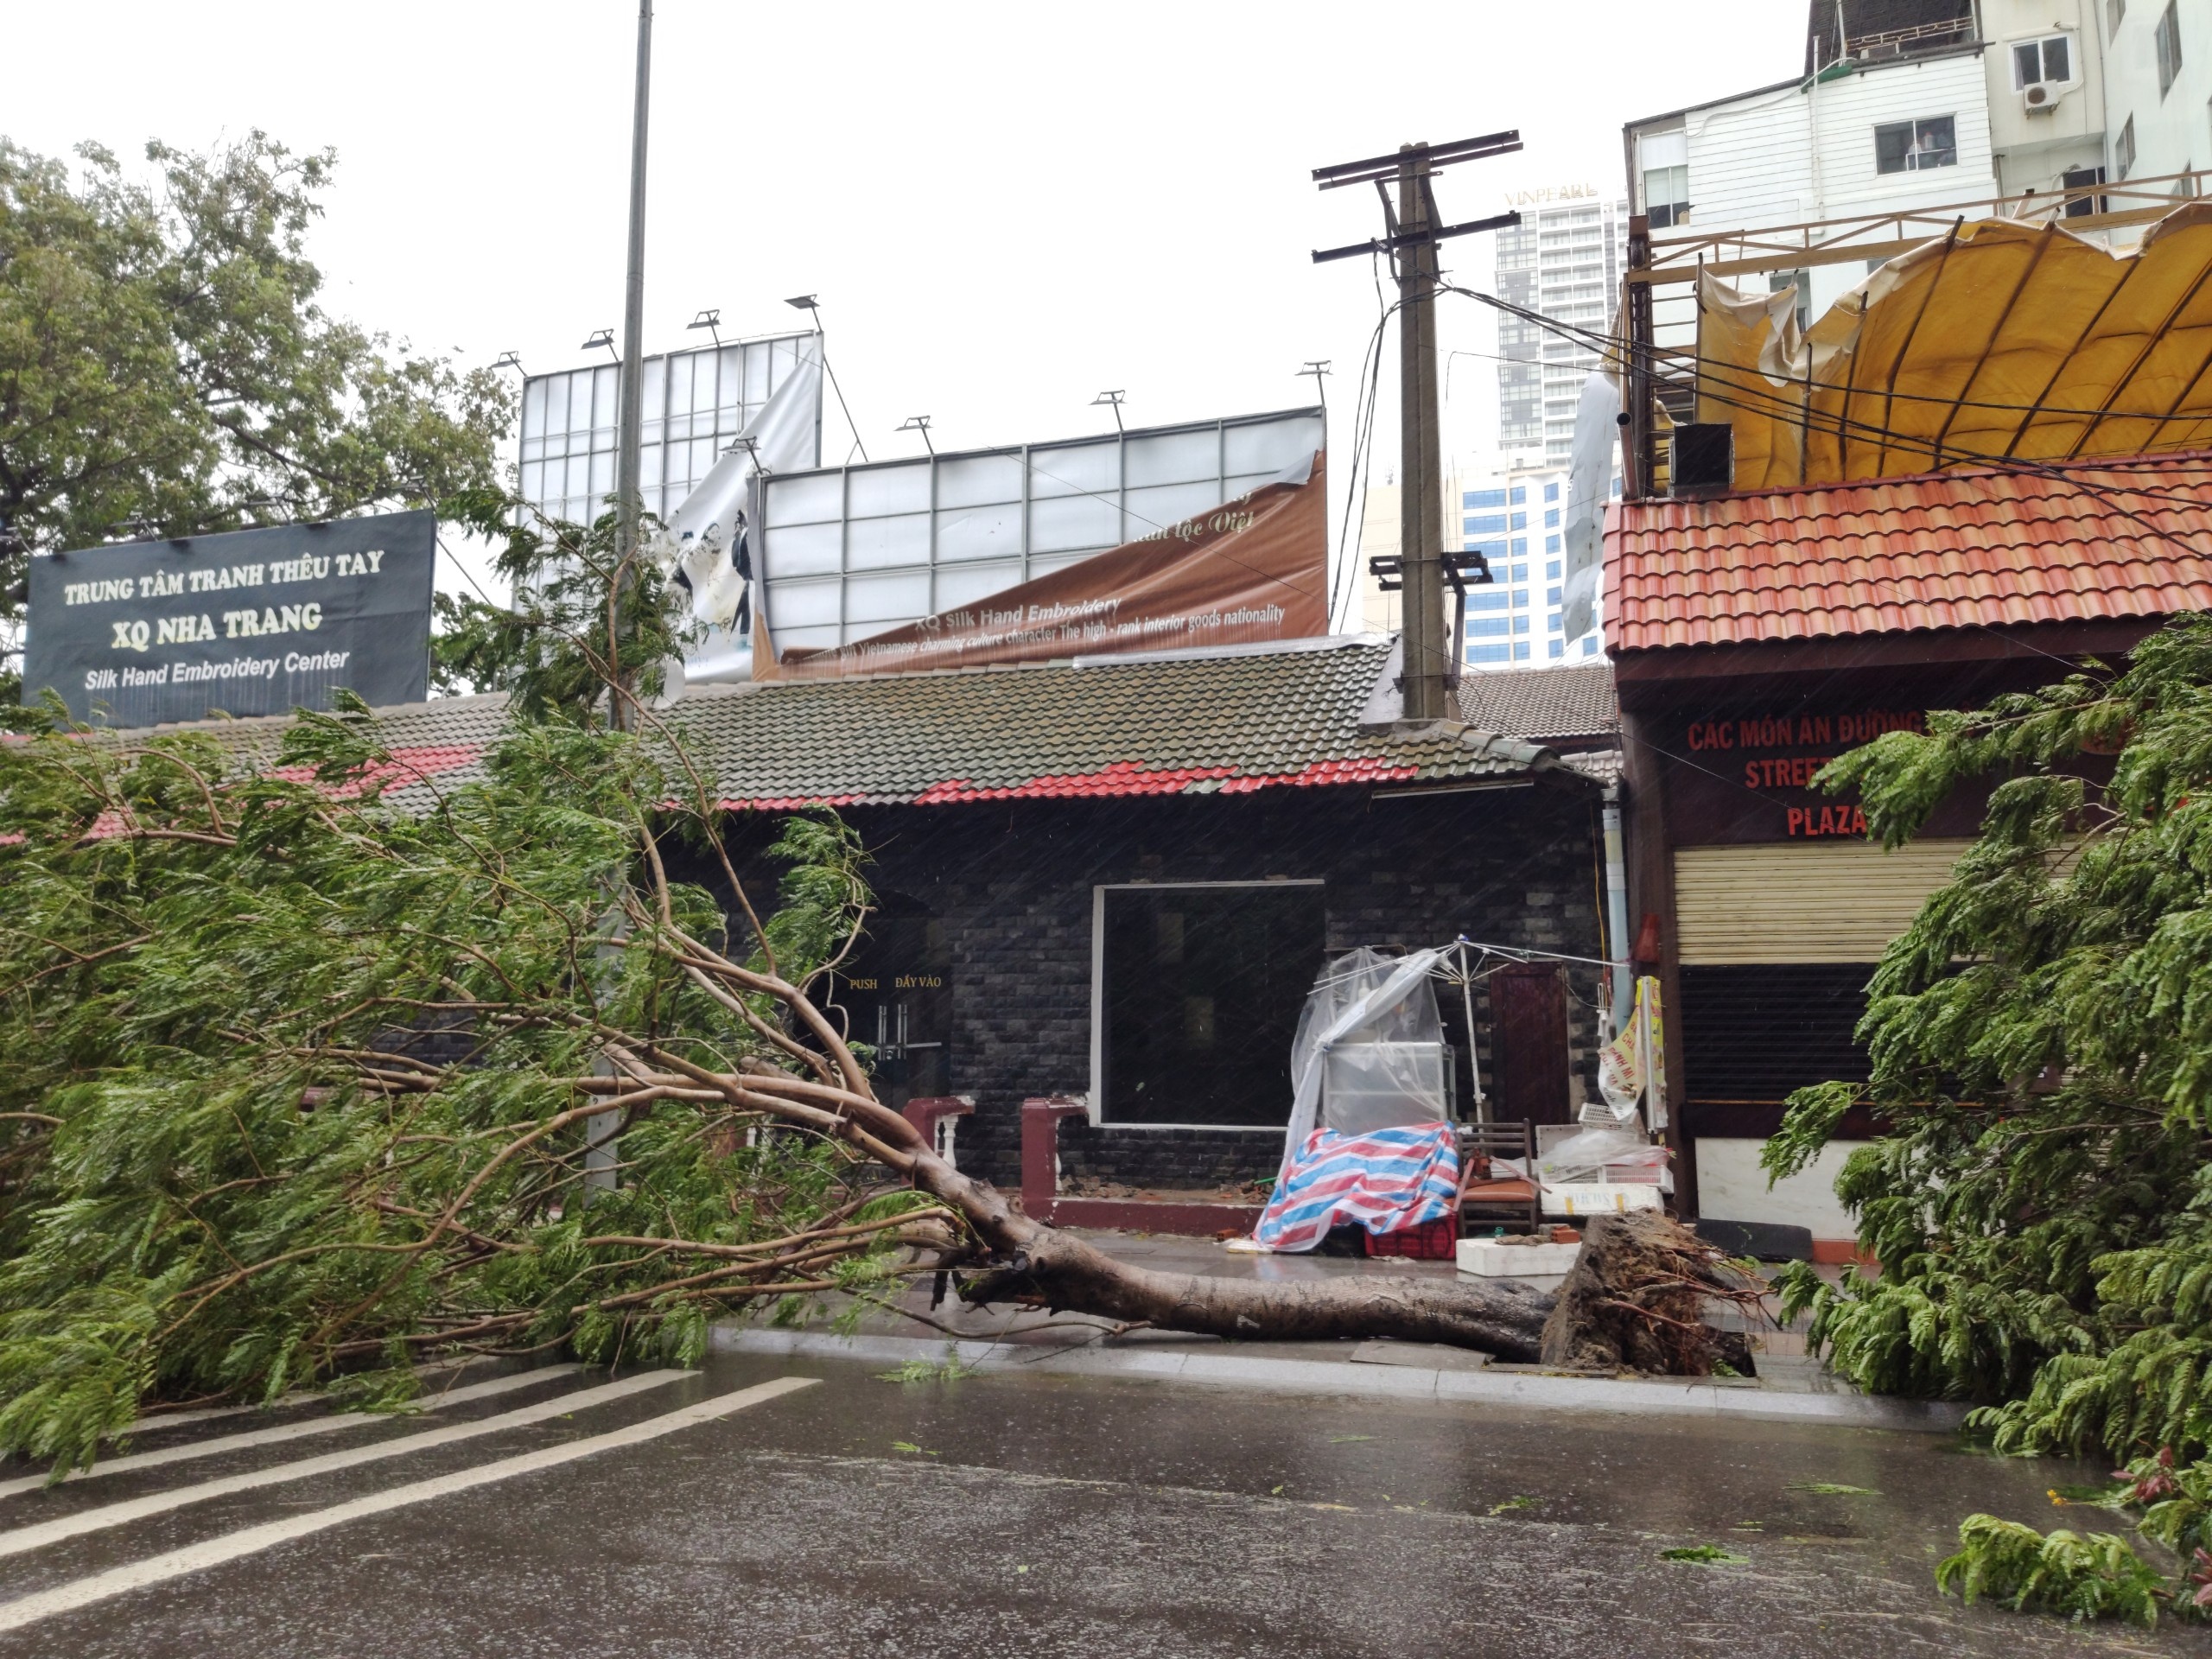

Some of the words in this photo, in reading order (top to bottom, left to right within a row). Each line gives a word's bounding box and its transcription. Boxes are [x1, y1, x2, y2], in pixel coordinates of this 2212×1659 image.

[1504, 182, 1599, 206] VINPEARL
[1209, 511, 1254, 533] Việt
[65, 579, 134, 605] TRUNG
[139, 569, 184, 598] TÂM
[188, 563, 264, 592] TRANH
[270, 553, 329, 583] THÊU
[335, 550, 385, 576] TAY
[111, 621, 149, 652] XQ
[156, 615, 215, 645] NHA
[222, 603, 323, 638] TRANG
[858, 640, 918, 657] Vietnamese
[920, 634, 964, 653] charming
[966, 630, 1003, 647] culture
[1006, 624, 1057, 643] character
[1059, 620, 1080, 639] The
[1084, 618, 1107, 641] high
[1116, 616, 1141, 635] rank
[1144, 613, 1186, 632] interior
[1188, 608, 1222, 632] goods
[1224, 604, 1285, 626] nationality
[915, 614, 940, 632] XQ
[946, 611, 975, 628] Silk
[980, 605, 1023, 626] Hand
[1028, 597, 1122, 623] Embroidery
[85, 669, 117, 690] Silk
[122, 662, 168, 687] Hand
[172, 655, 280, 684] Embroidery
[284, 649, 350, 673] Center
[1688, 715, 1734, 751] CÁC
[1740, 713, 1793, 747] MÓN
[1798, 710, 1831, 745] ĂN
[1788, 805, 1867, 836] PLAZA
[850, 978, 878, 989] PUSH
[918, 974, 942, 988] VÀO
